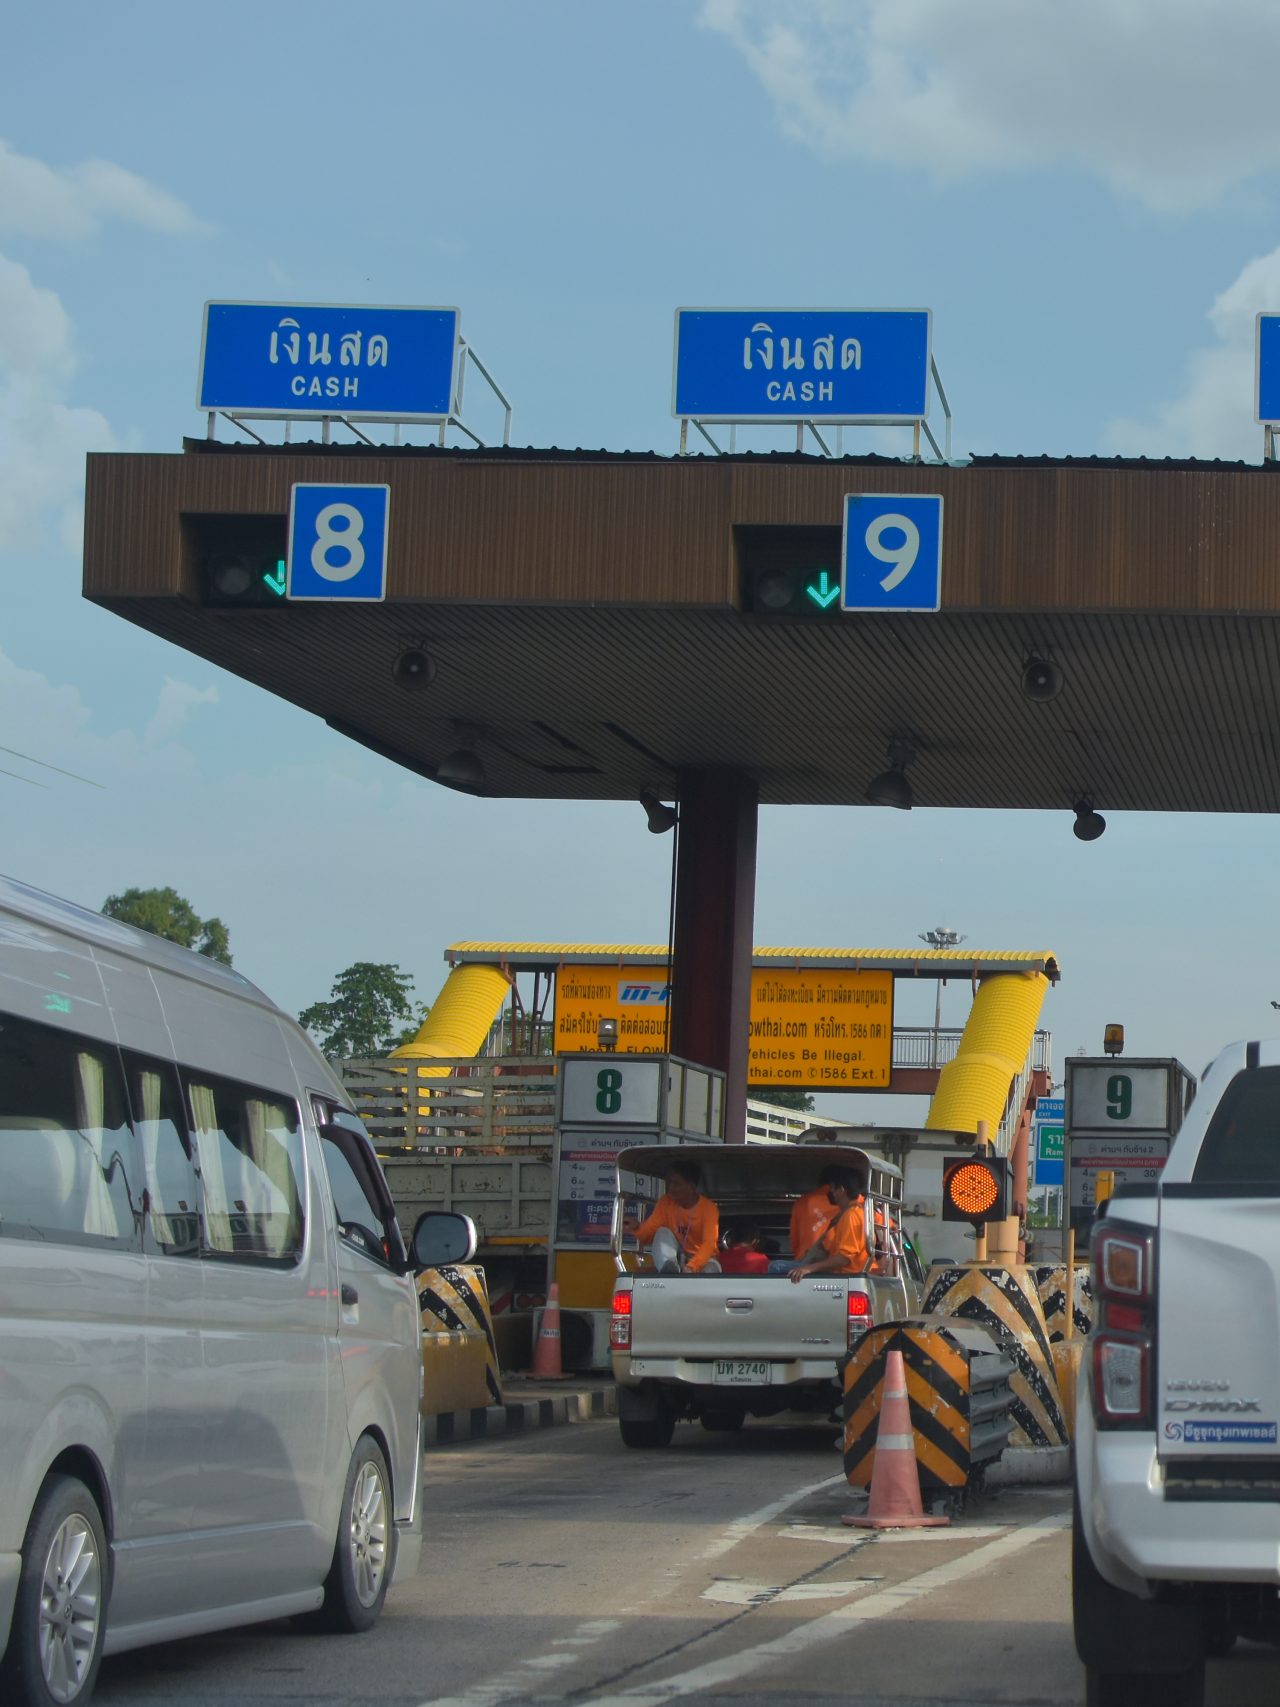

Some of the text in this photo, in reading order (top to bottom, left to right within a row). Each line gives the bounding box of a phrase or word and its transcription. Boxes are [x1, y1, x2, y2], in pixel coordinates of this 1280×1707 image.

[269, 317, 388, 366] เงินสด
[744, 322, 861, 370] เงินสด
[291, 376, 358, 397] CASH
[767, 381, 833, 401] CASH
[311, 503, 365, 582] 8
[865, 513, 920, 592] 9
[802, 1049, 818, 1060] Be
[824, 1049, 866, 1064] Illegal.
[820, 1067, 848, 1079] 1586
[852, 1068, 878, 1080] Ext.
[595, 1068, 623, 1115] 8
[1106, 1074, 1133, 1120] 9
[1144, 1169, 1156, 1178] 30
[738, 1363, 766, 1375] 2740
